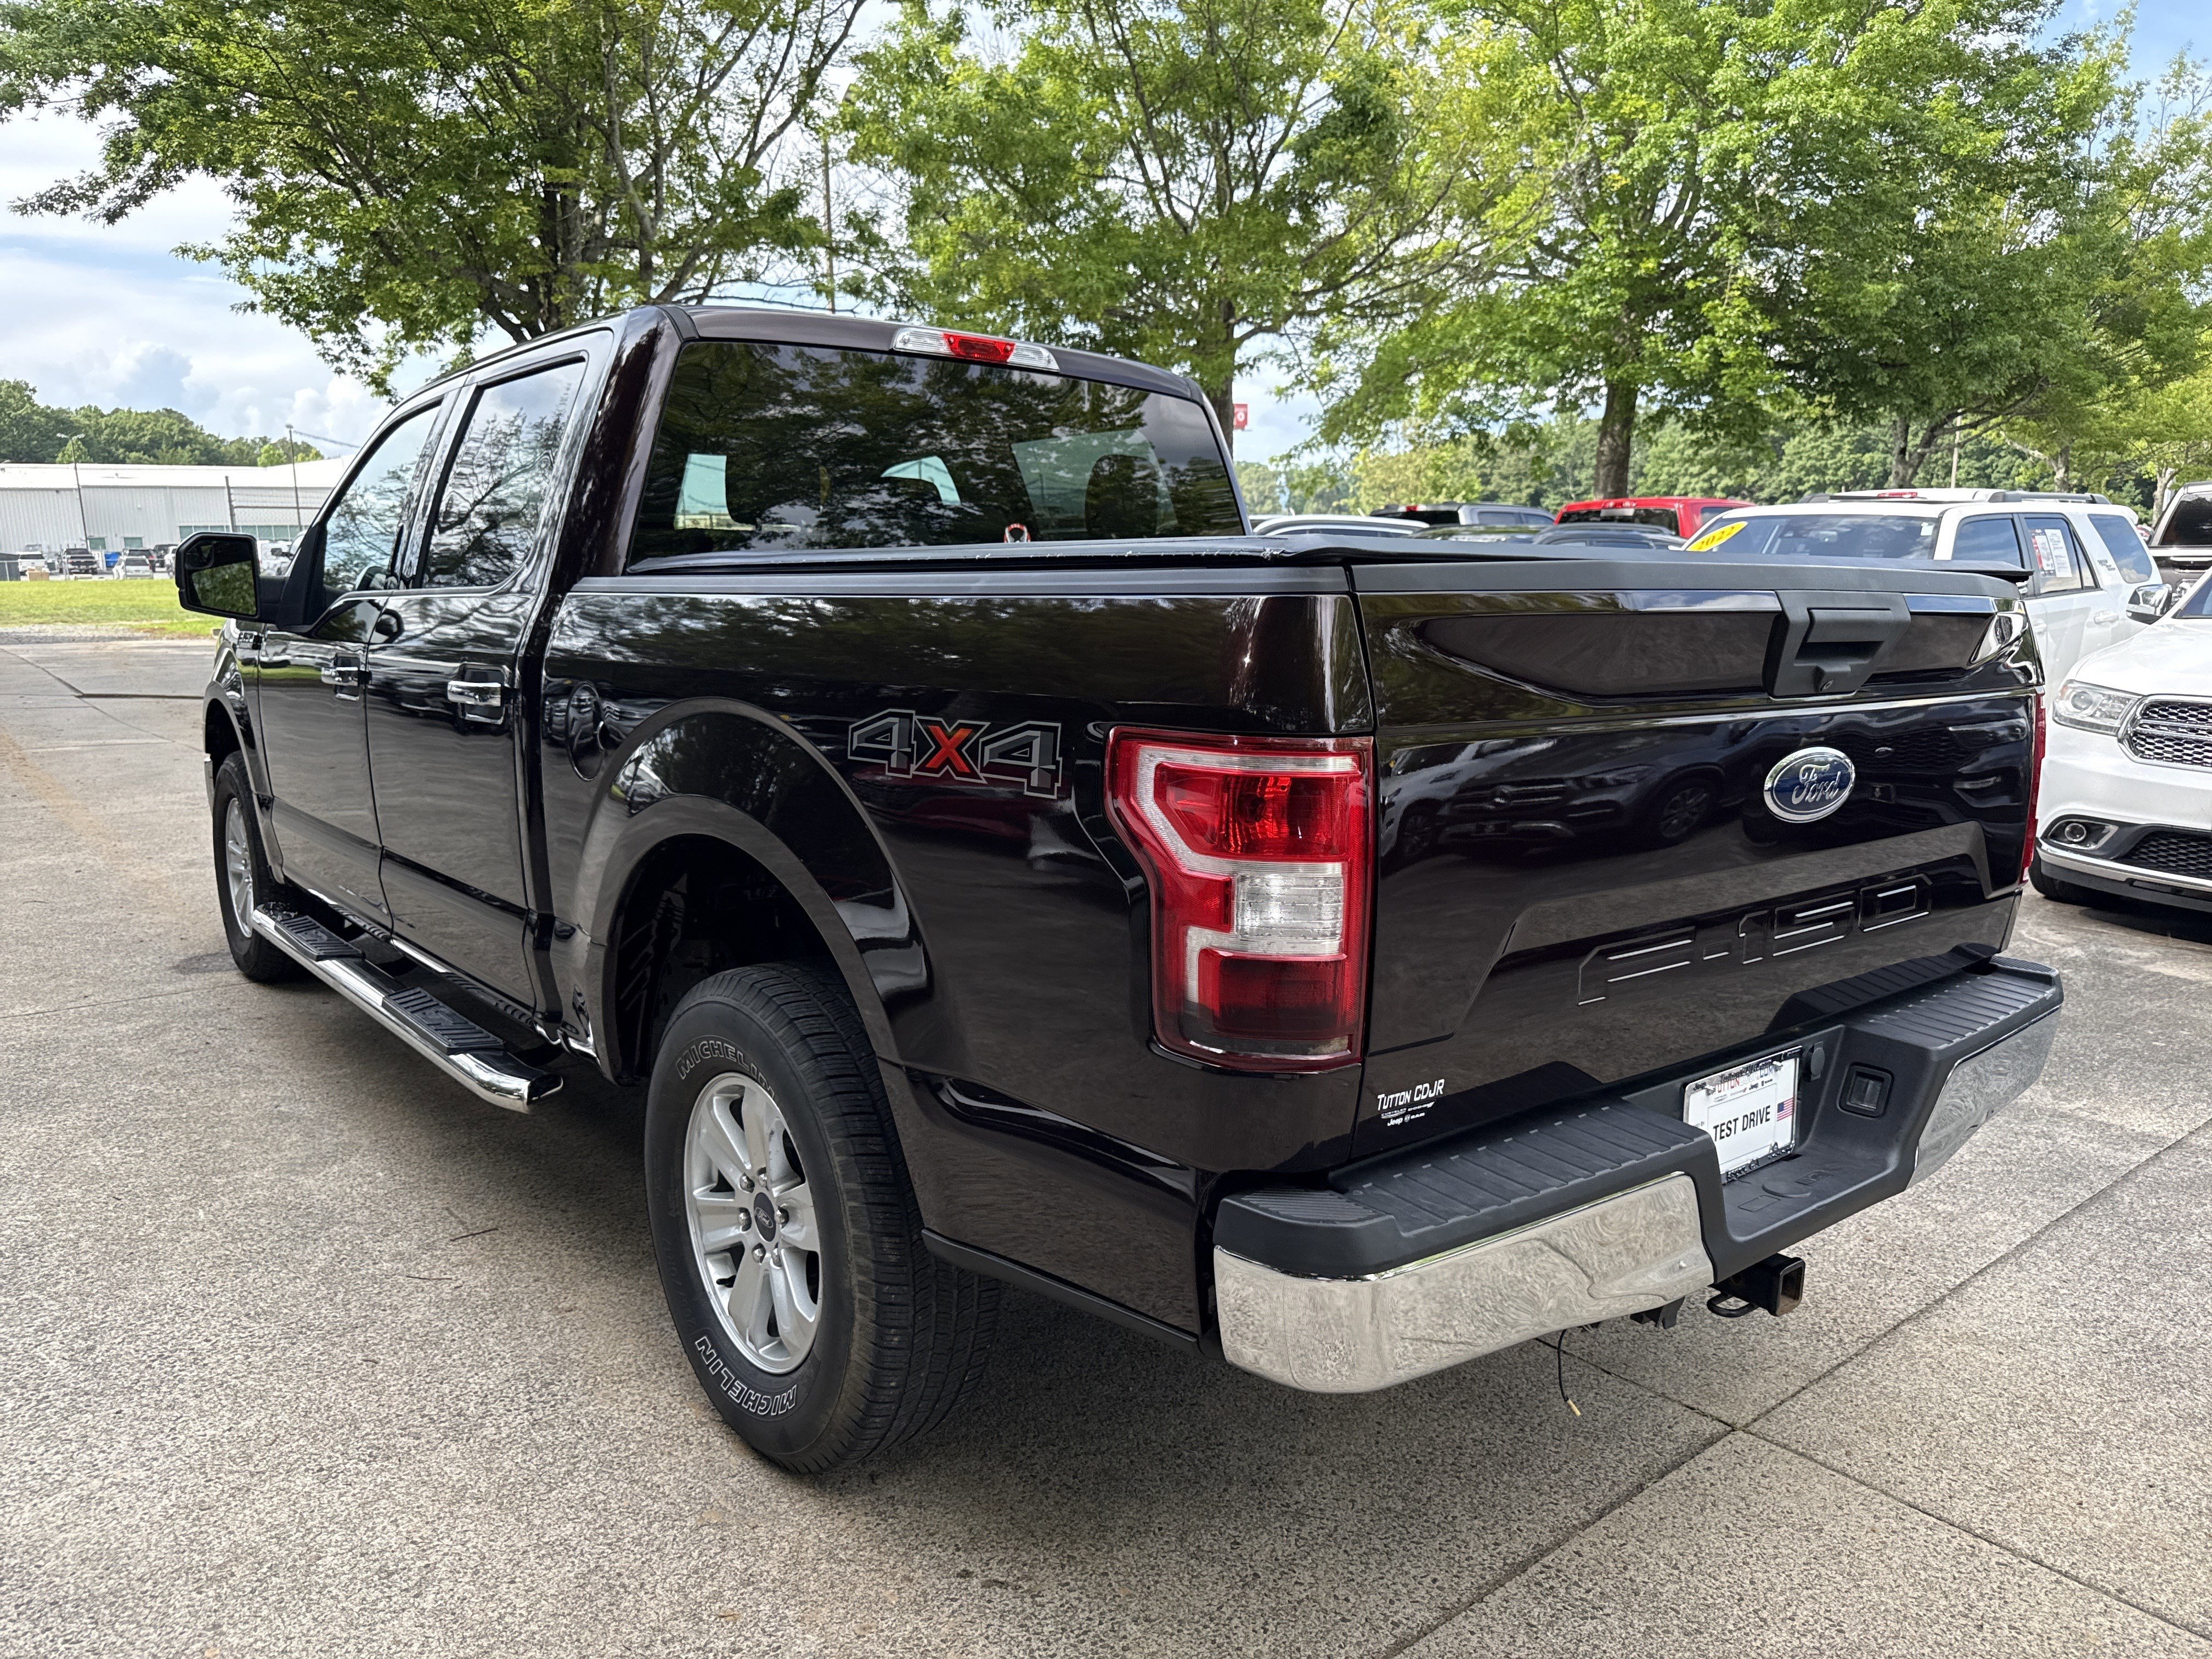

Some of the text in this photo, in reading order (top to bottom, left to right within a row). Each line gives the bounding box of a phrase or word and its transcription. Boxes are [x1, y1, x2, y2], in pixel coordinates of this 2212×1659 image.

[848, 708, 1063, 799] 4X4
[1792, 764, 1842, 805] Ford
[1577, 873, 1933, 1006] F-150
[675, 1040, 775, 1101] MICHELIN
[1377, 1079, 1445, 1111] TUTTON CDJR
[1387, 1117, 1403, 1126] Jeep
[1713, 1105, 1771, 1142] TEST DRIVE
[695, 1335, 798, 1417] MICHELIN
